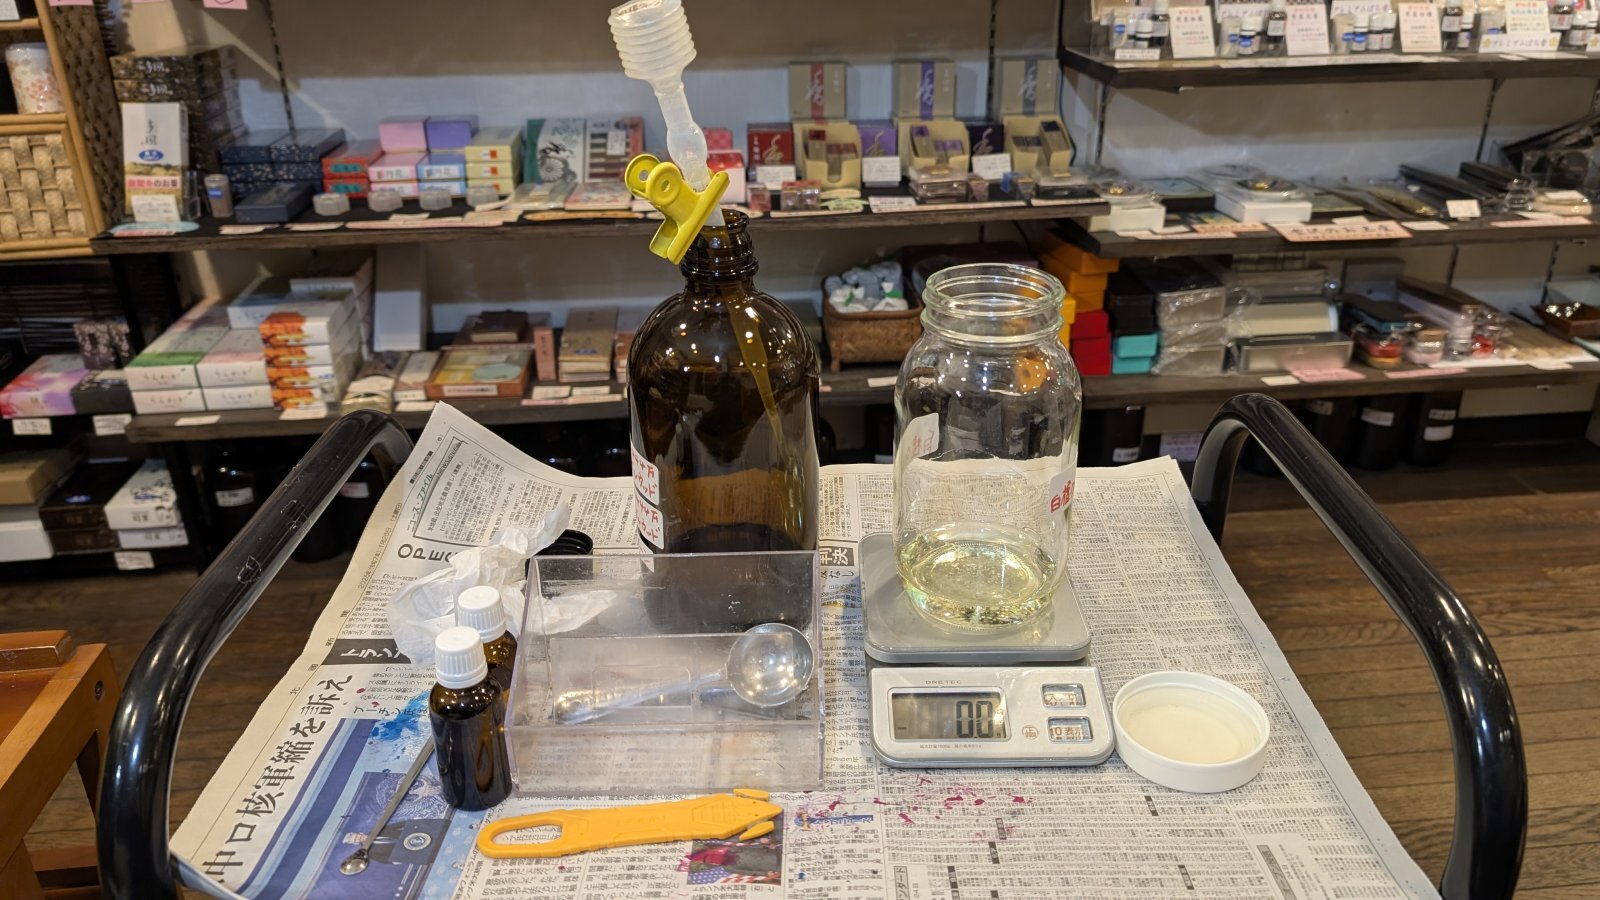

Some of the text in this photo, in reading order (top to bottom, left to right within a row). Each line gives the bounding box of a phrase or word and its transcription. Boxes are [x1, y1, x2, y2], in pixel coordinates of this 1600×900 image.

[202, 675, 353, 884] 中ロ核軍縮を訴え
[895, 867, 908, 900] ンダード
